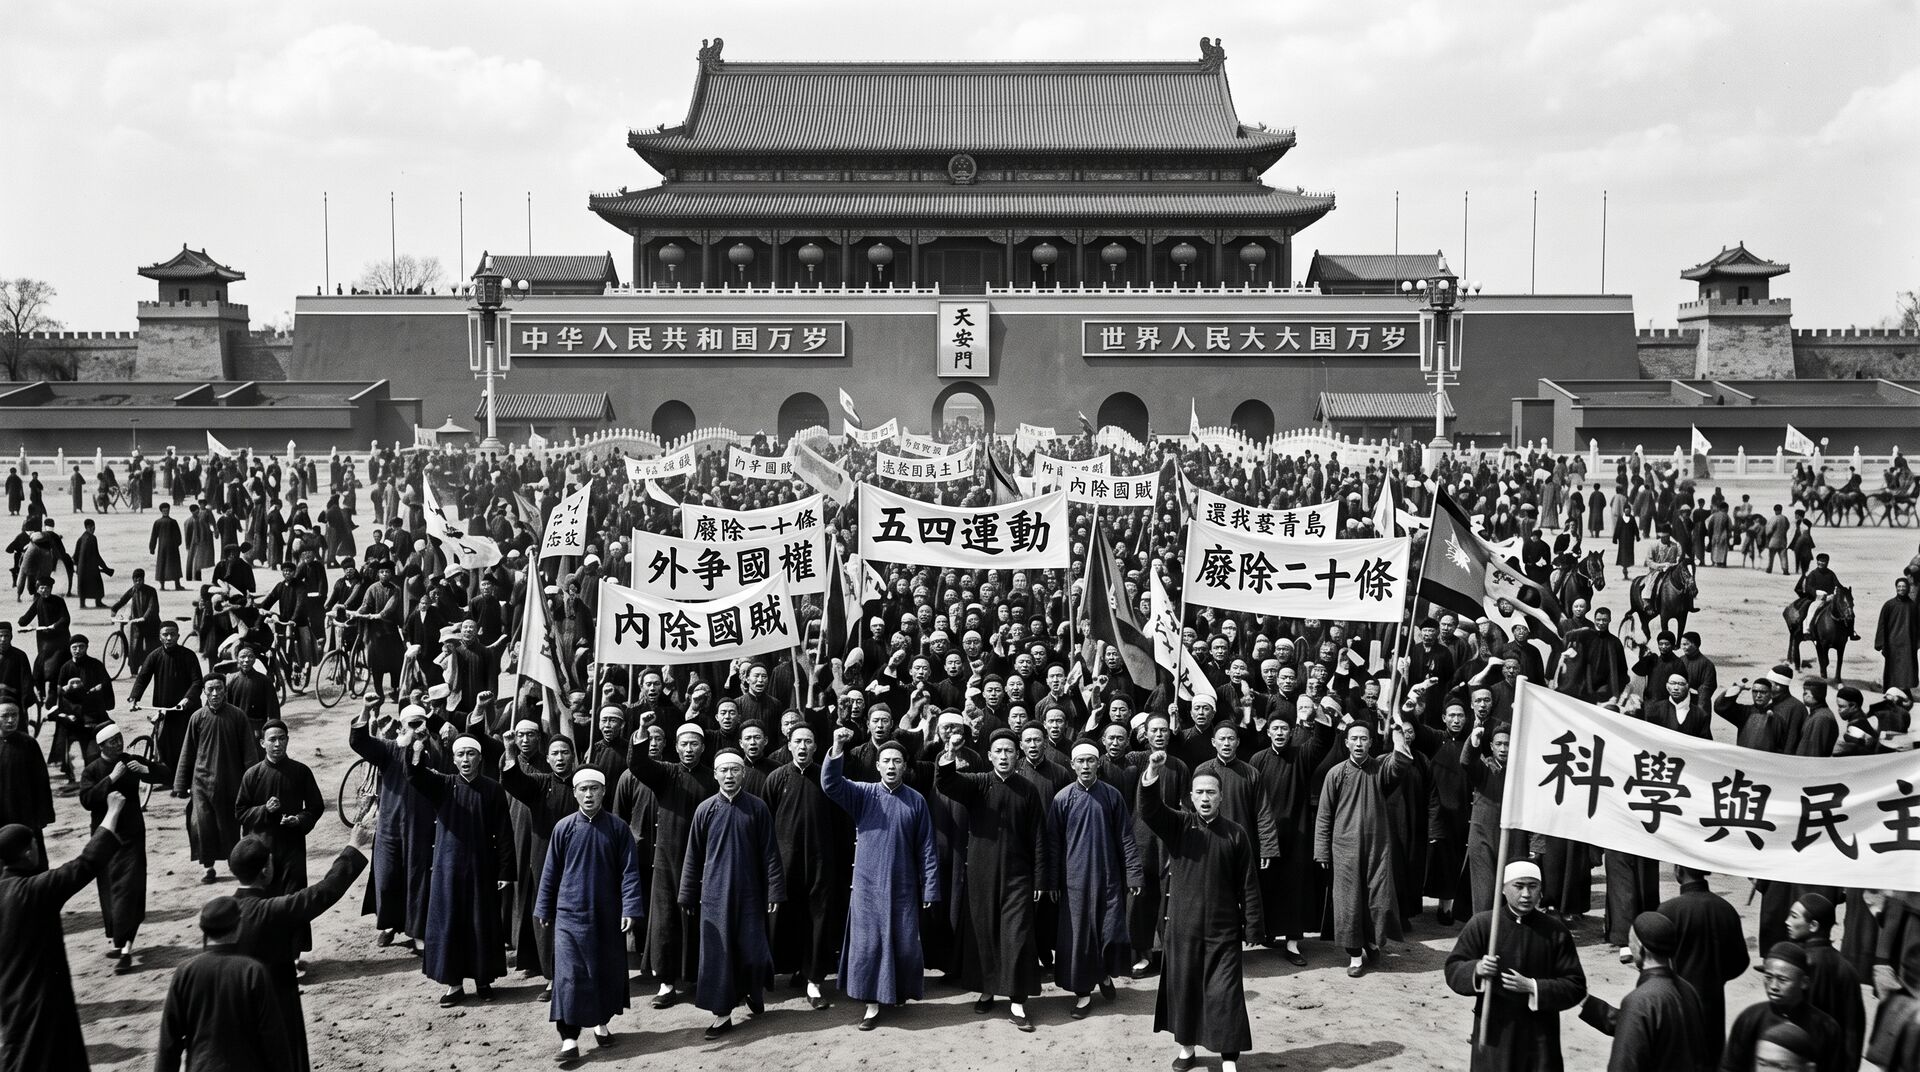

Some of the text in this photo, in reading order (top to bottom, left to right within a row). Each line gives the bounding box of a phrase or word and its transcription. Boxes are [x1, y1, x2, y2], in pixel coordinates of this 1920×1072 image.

[522, 327, 827, 351] 中华人民共和国万岁
[952, 308, 976, 370] 天安門
[1100, 326, 1405, 351] 世界人民大大国万岁
[872, 507, 1050, 555] 五四運動
[1195, 543, 1398, 601] 廢除二十條
[1538, 730, 1920, 860] 科學與民主
